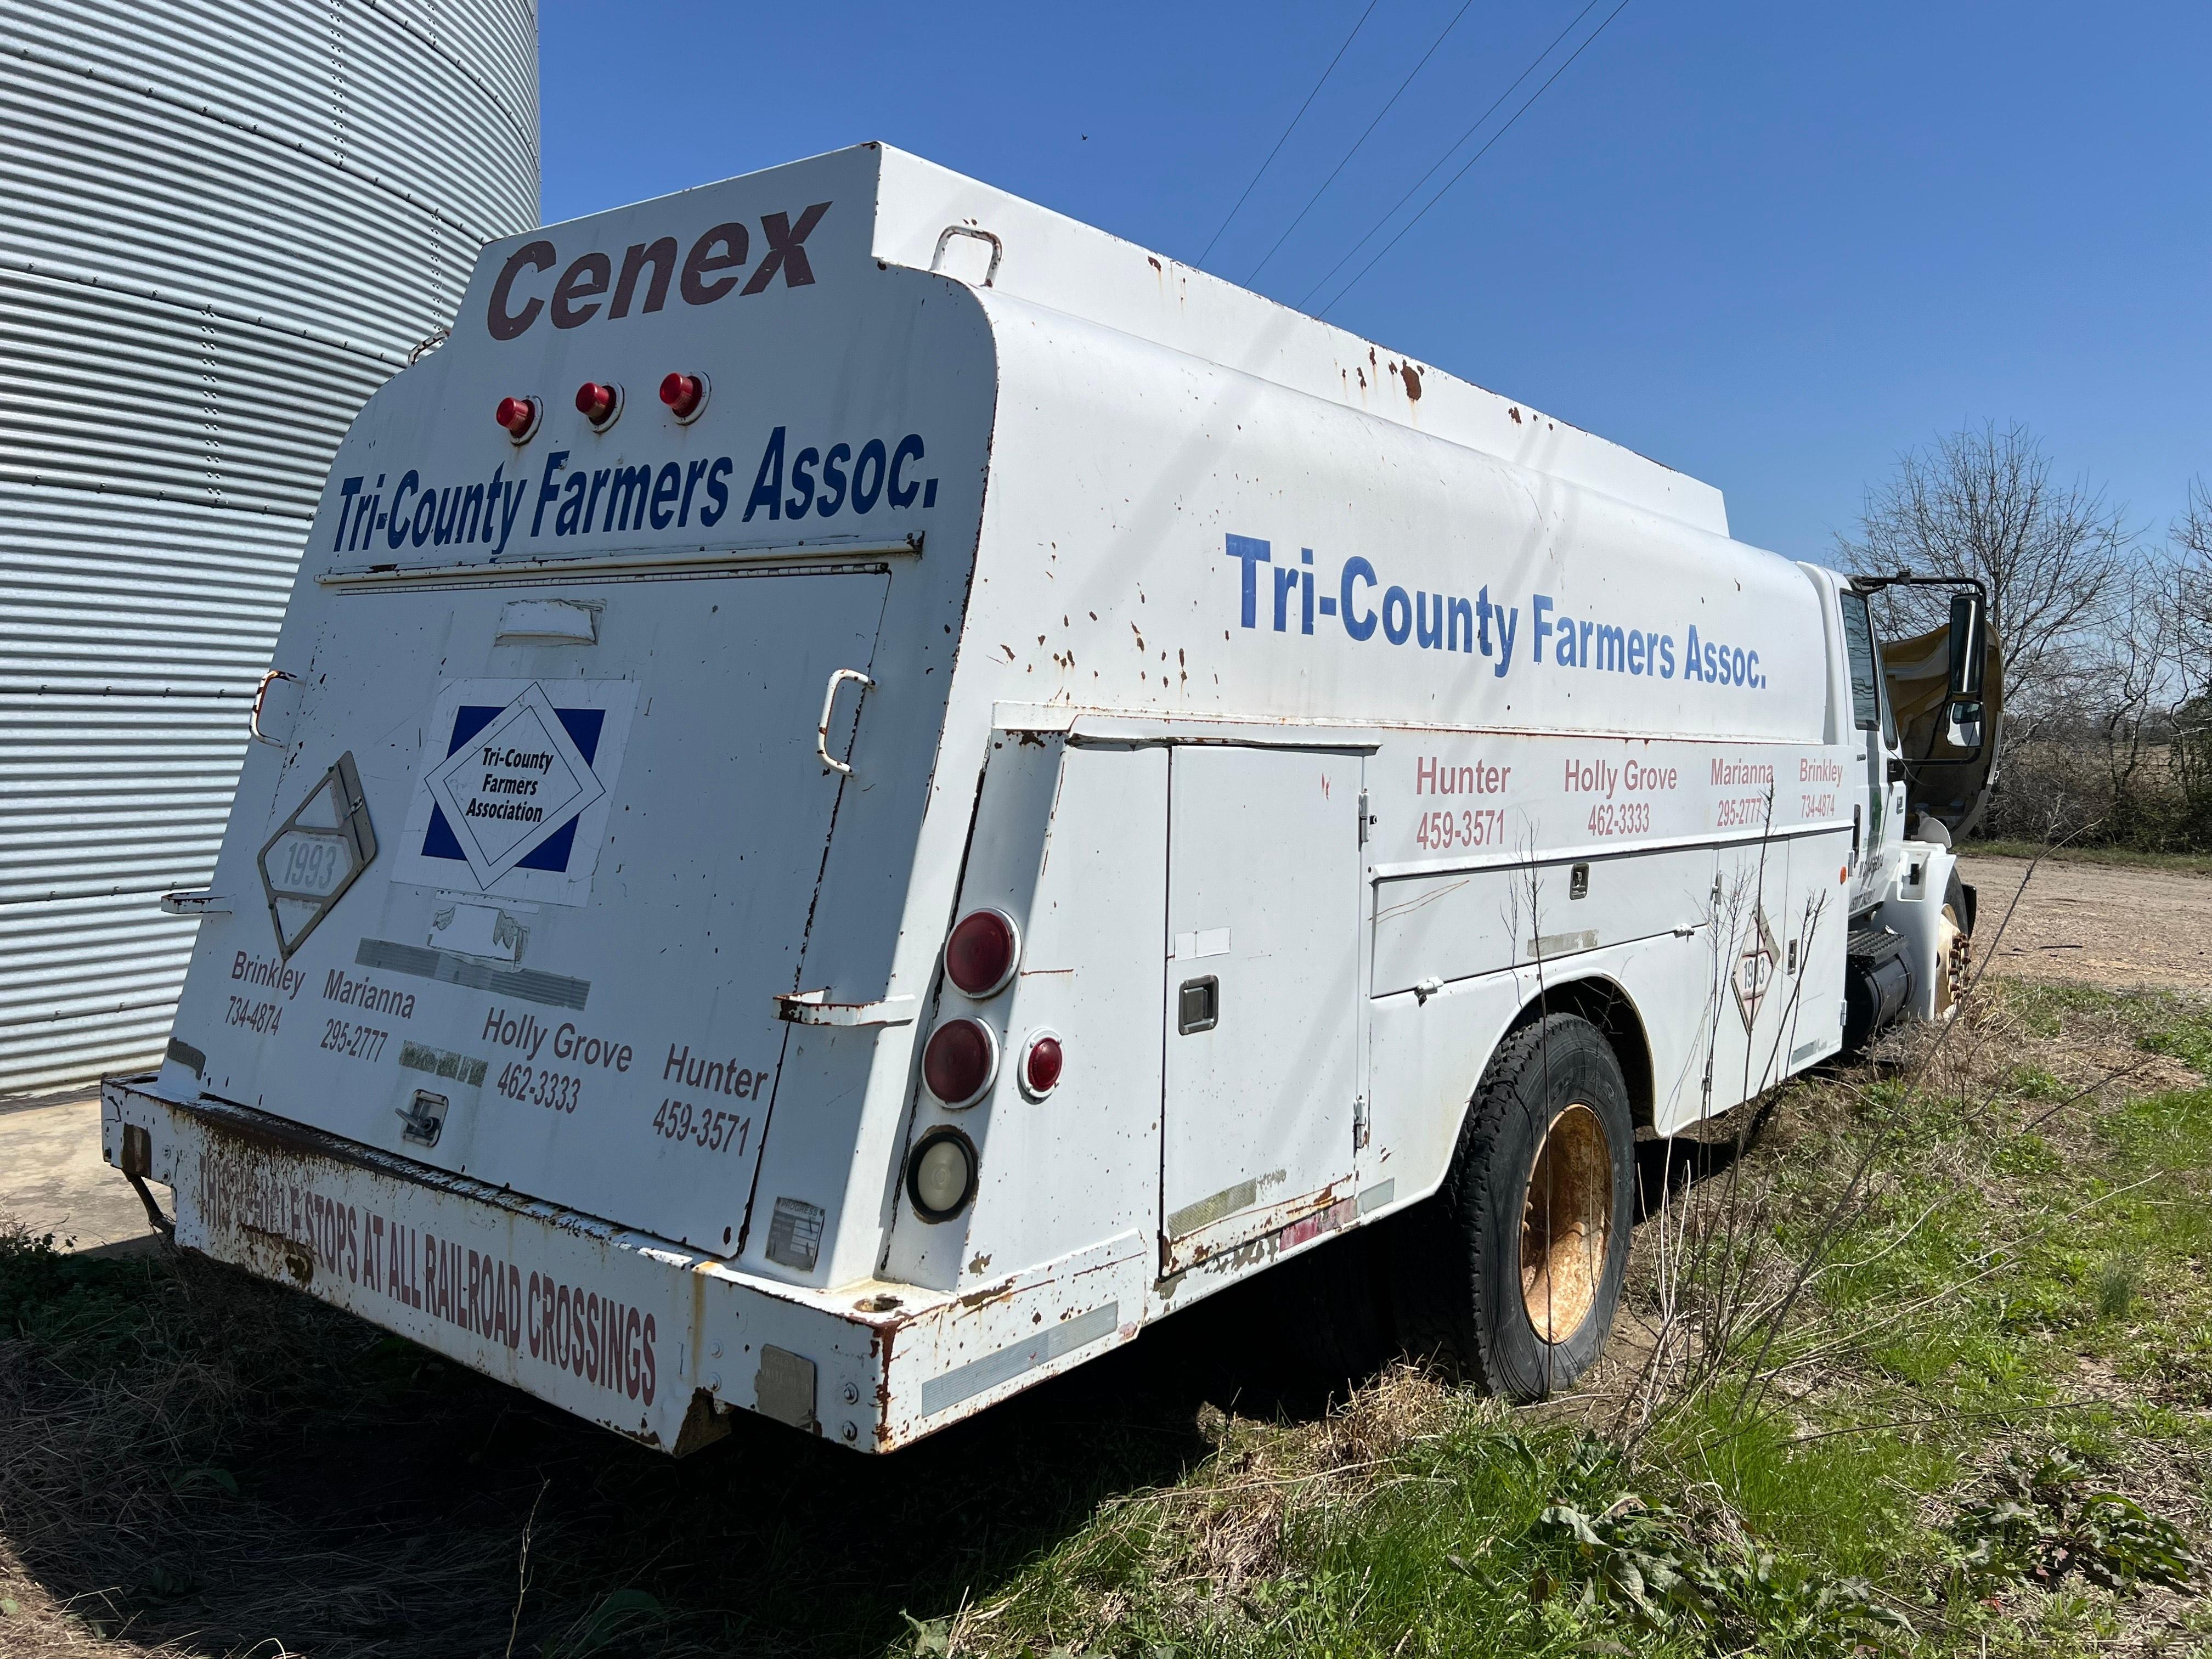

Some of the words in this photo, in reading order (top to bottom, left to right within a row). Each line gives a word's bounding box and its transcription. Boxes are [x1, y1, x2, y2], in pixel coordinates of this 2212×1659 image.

[488, 201, 833, 341] Cenex
[333, 460, 528, 555] Tri-County
[529, 451, 732, 538] Farmers
[742, 426, 939, 522] Assoc.
[1226, 533, 1518, 678] Tri-County
[1533, 594, 1675, 679] Farmers
[1684, 624, 1766, 689] Assoc.
[483, 747, 554, 775] Tri-County
[1417, 757, 1511, 795] Hunter
[1565, 759, 1618, 799] Holly
[1624, 760, 1677, 790] Grove
[1711, 758, 1774, 786] Marianna
[1799, 758, 1843, 788] Brinkley
[482, 774, 538, 795] Farmers
[466, 798, 543, 822] Association
[1588, 803, 1650, 836] 462-3333
[1717, 798, 1762, 826] 295-2777
[1801, 794, 1835, 818] 734-4874
[1417, 809, 1504, 850] 459-3571
[284, 842, 337, 889] 1993
[232, 951, 306, 1000] Brinkley
[323, 969, 415, 1019] Marianna
[225, 996, 283, 1036] 734-4874
[320, 1019, 388, 1062] 295-2777
[482, 1007, 548, 1060] Holly
[554, 1023, 633, 1072] Grove
[498, 1062, 580, 1113] 462-3333
[663, 1043, 769, 1101] Hunter
[653, 1098, 751, 1156] 459-3571
[781, 1201, 818, 1216] PROGRESS
[305, 1191, 358, 1283] STOPS
[363, 1212, 383, 1293] AT
[389, 1222, 421, 1310] ALL
[425, 1233, 521, 1350] RAILROAD
[528, 1271, 656, 1407] CROSSINGS
